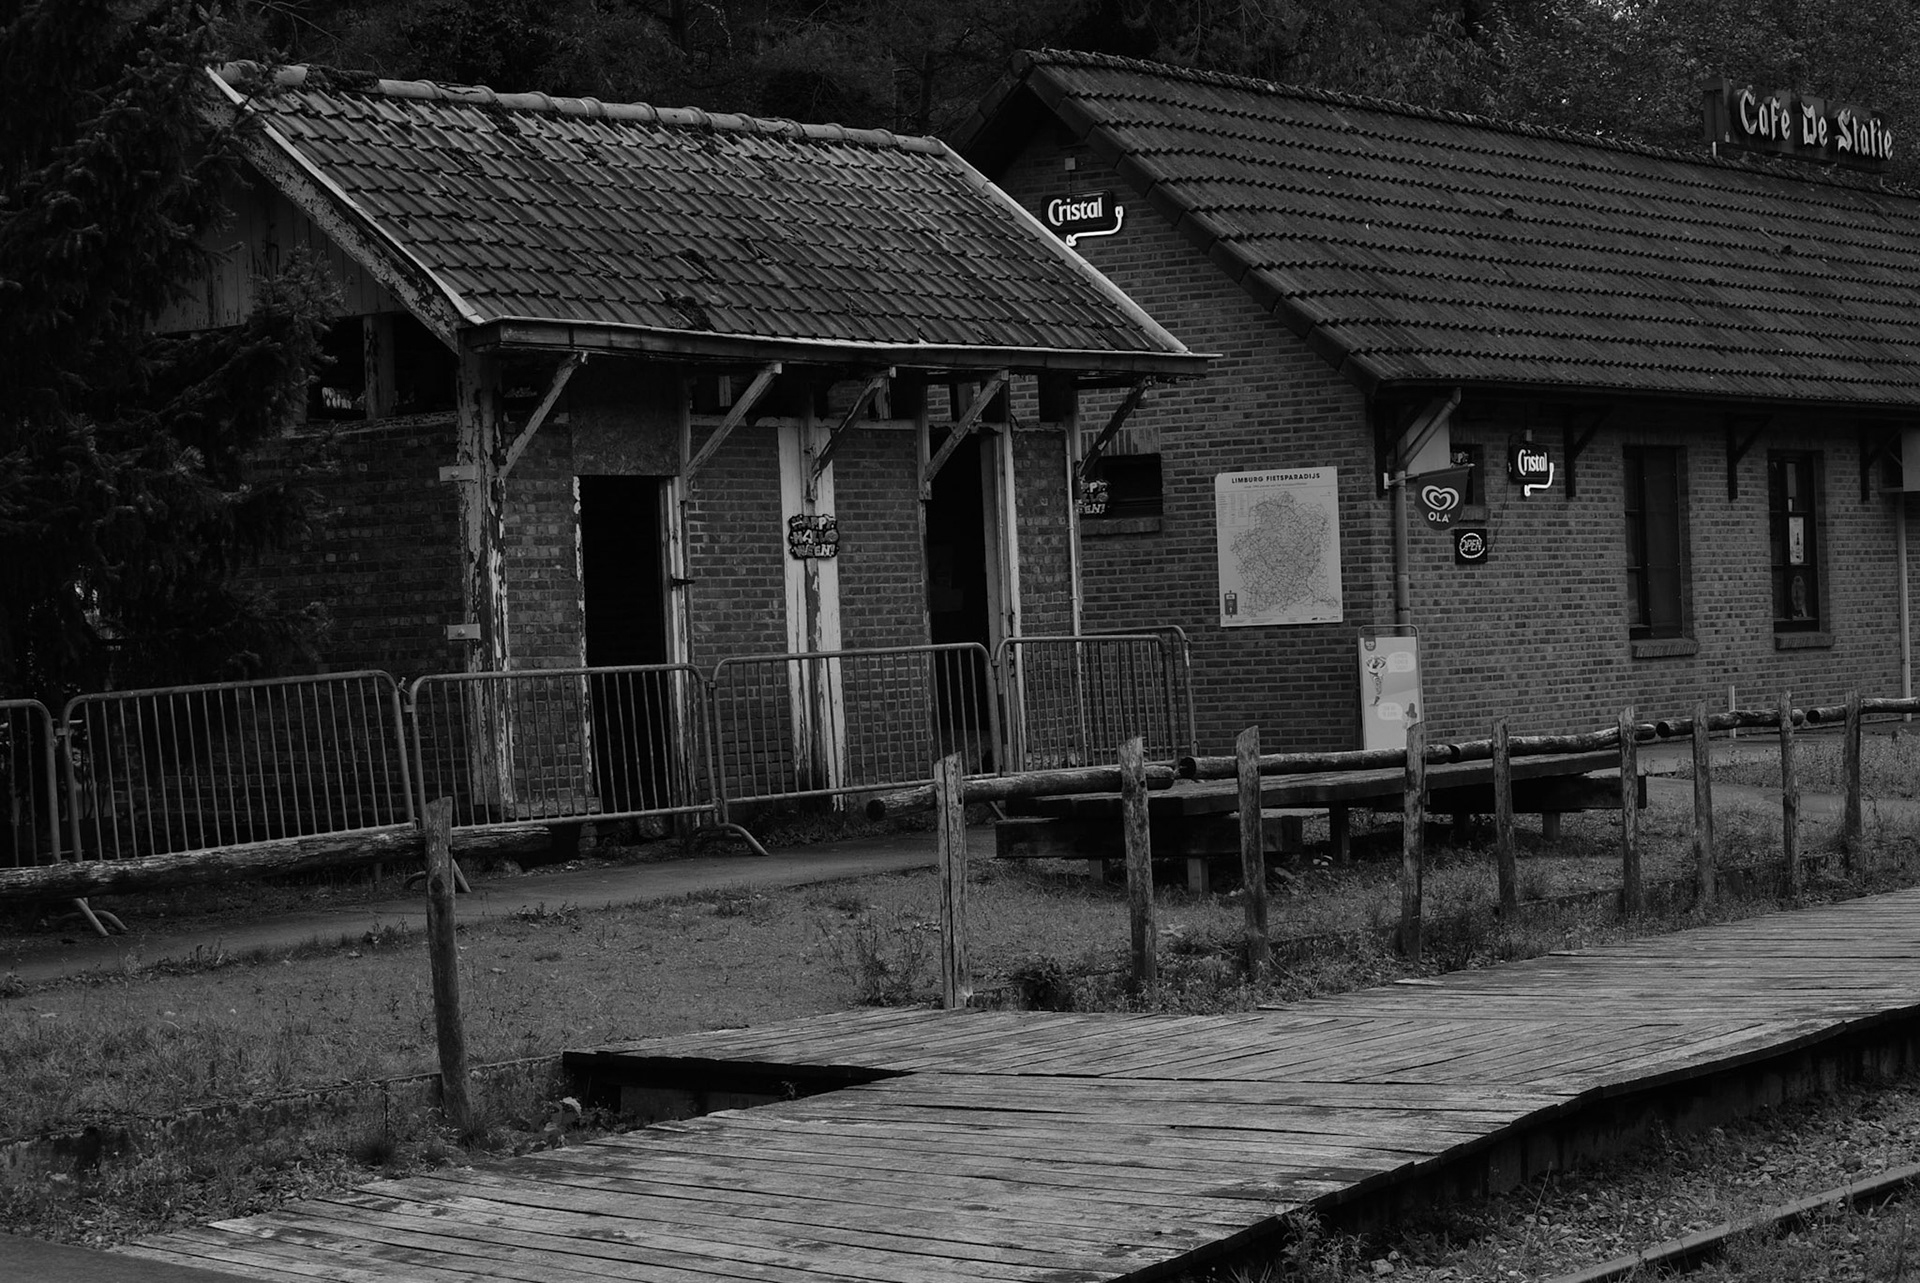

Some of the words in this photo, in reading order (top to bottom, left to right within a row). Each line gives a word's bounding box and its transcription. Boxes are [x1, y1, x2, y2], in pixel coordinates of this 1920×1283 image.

[1739, 87, 1791, 141] Cafe
[1800, 101, 1828, 147] De
[1835, 107, 1894, 161] Statie
[1047, 196, 1103, 226] Cristal
[1517, 448, 1548, 476] Cristal
[1231, 475, 1264, 484] LIMBURG
[1265, 473, 1320, 482] FIETSPARADIJS
[1427, 510, 1450, 523] OLA
[1459, 538, 1482, 552] OPEN
